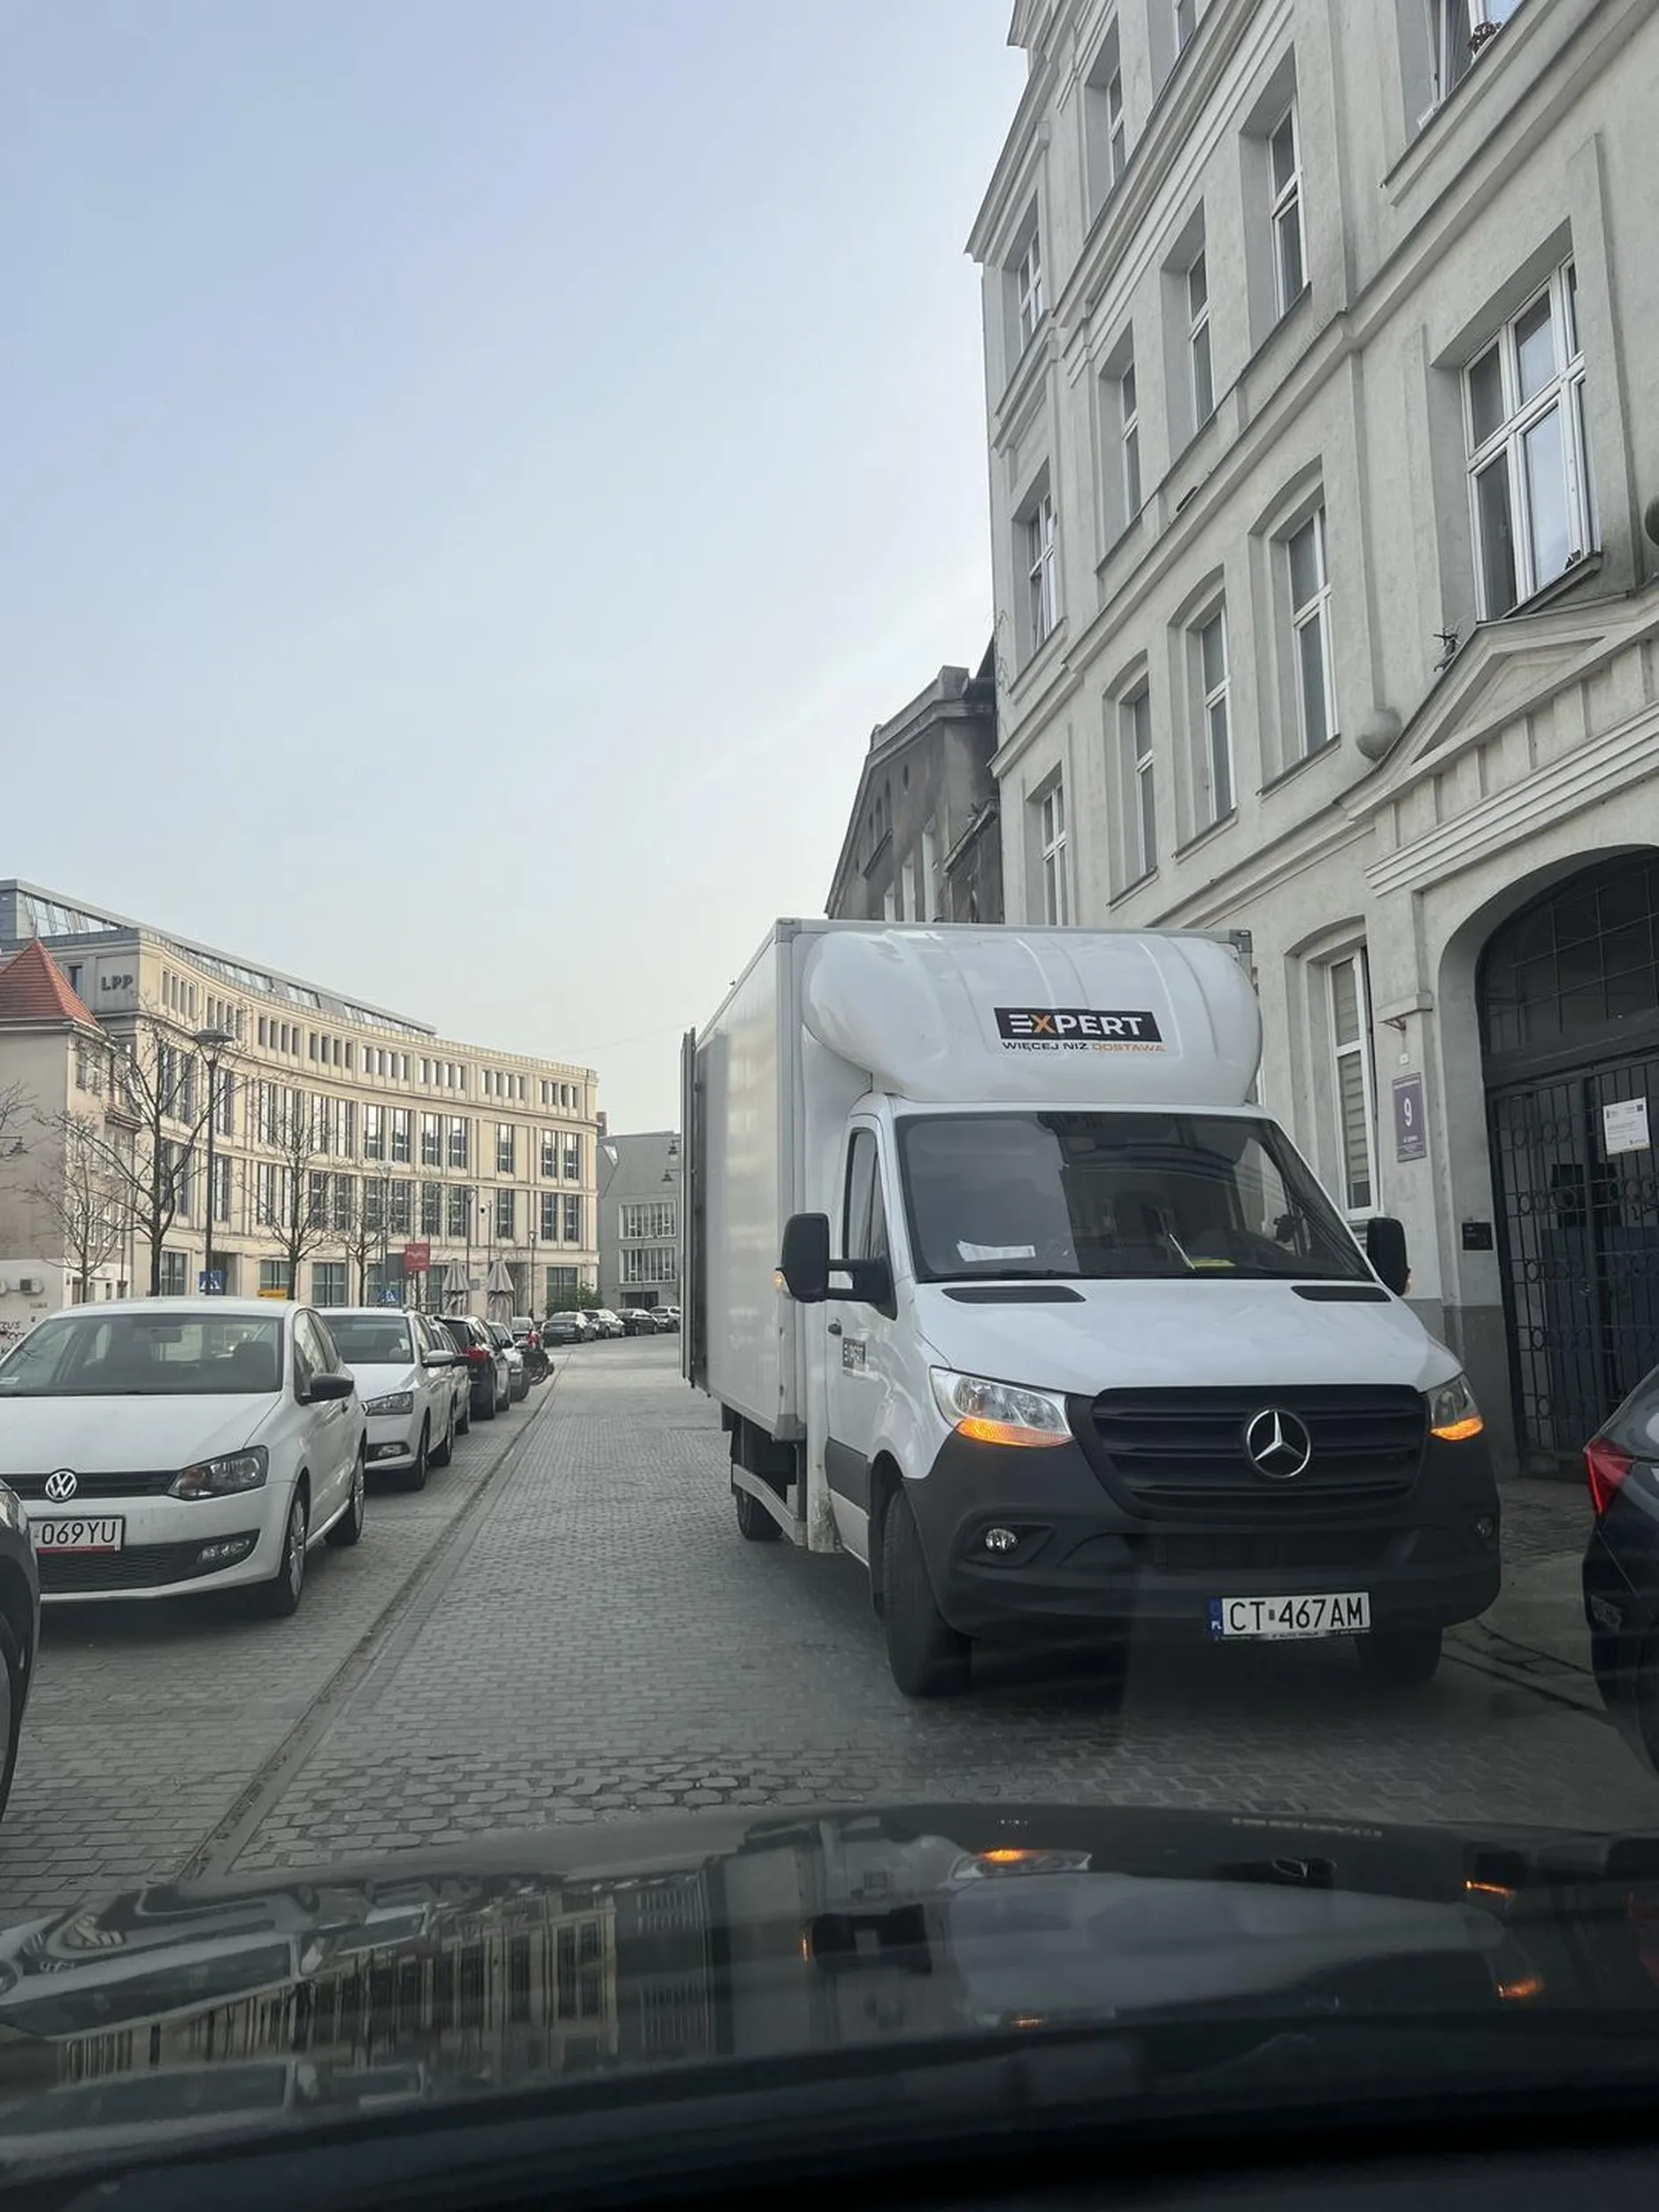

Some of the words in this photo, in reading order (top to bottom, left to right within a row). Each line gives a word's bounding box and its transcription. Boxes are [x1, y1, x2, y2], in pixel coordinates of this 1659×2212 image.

[101, 975, 134, 991] LPP
[1009, 1013, 1143, 1036] EXPERT
[1093, 1043, 1166, 1052] DOSTAWA
[1404, 1097, 1413, 1126] 9
[42, 1521, 117, 1545] 069YU
